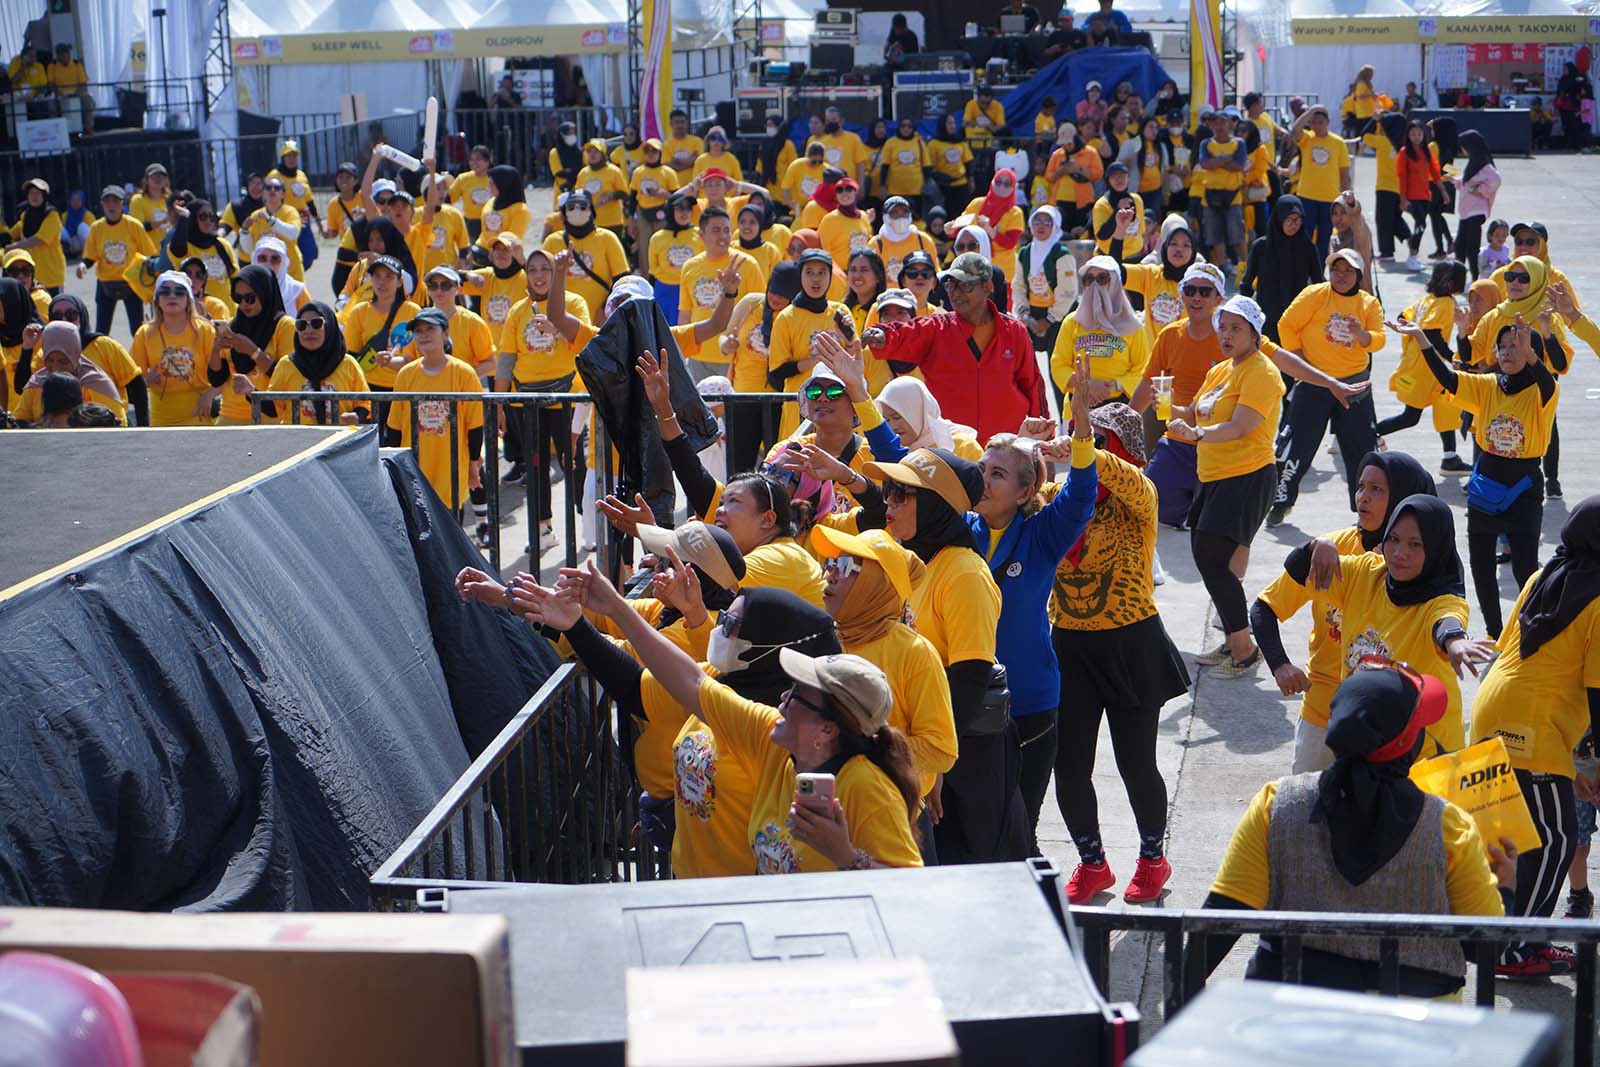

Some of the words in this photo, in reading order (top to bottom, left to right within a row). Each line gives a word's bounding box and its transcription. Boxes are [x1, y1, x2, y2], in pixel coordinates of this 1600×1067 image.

[1347, 24, 1390, 35] Ramyun
[1446, 24, 1511, 33] KANAYAMA
[1519, 23, 1576, 33] TAKOYAKI
[312, 41, 347, 52] SLEEP
[350, 40, 382, 50] WELL
[485, 36, 544, 47] OLDPROW
